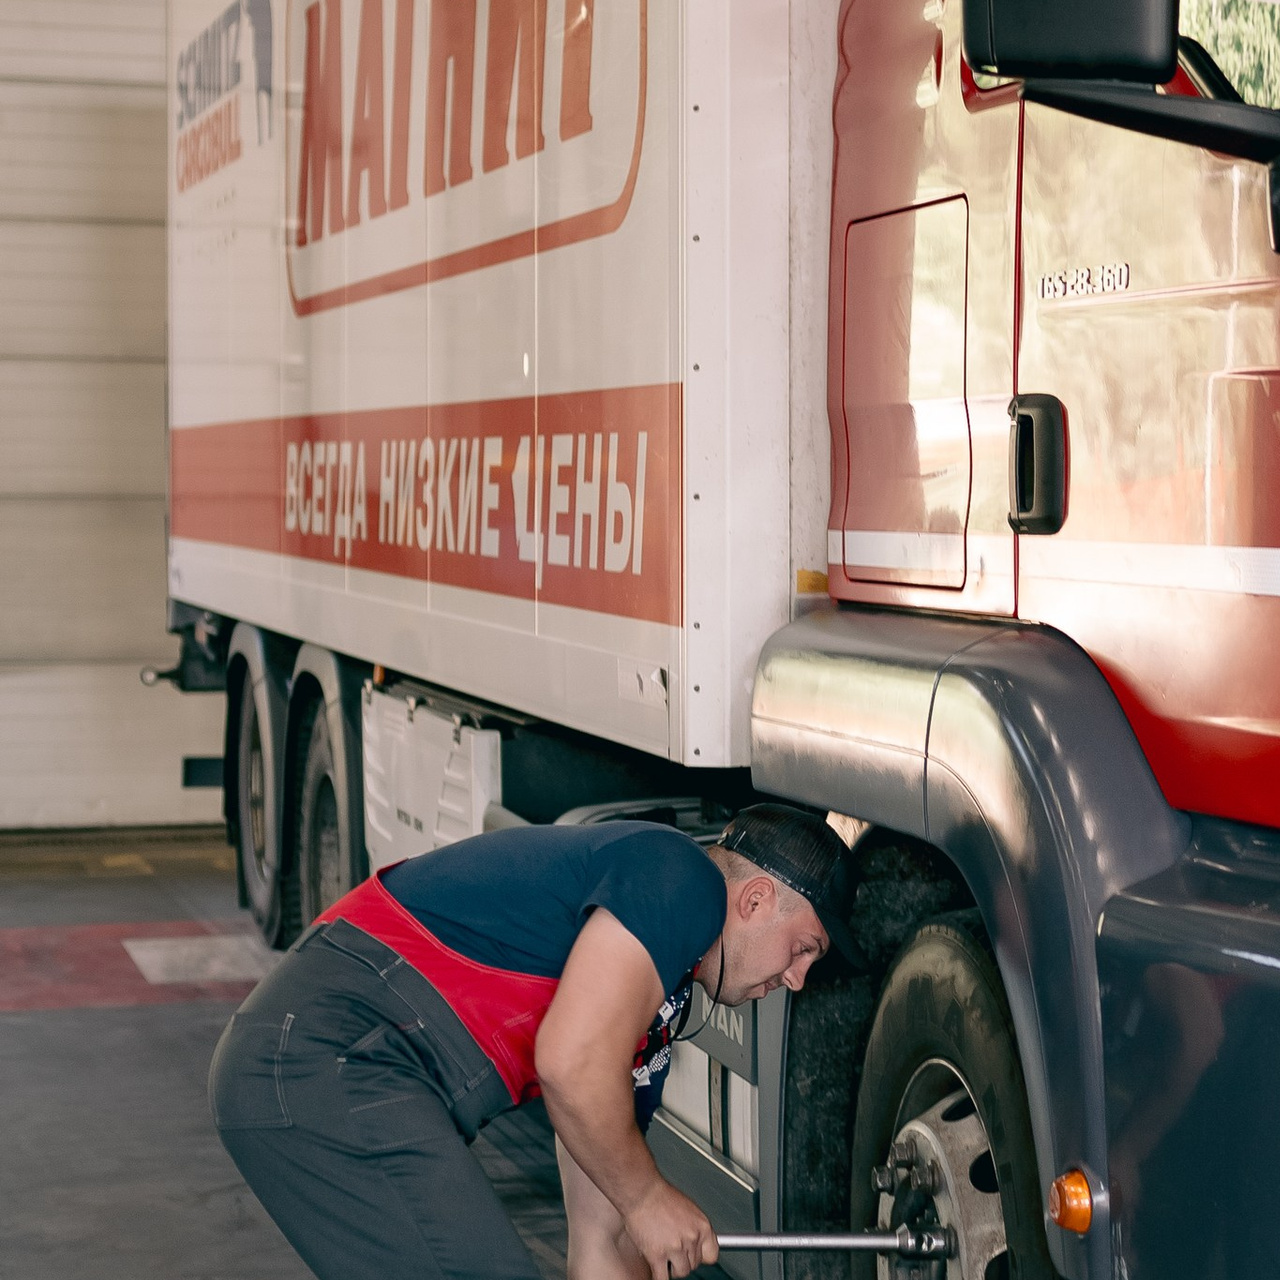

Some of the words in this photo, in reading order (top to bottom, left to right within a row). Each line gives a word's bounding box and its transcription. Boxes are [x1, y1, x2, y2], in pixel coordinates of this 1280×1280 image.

[285, 441, 367, 557] ВСЕГДА
[378, 437, 503, 557] НИЗКИЕ
[511, 431, 648, 589] ЦЕНЫ
[702, 991, 744, 1047] MAN
